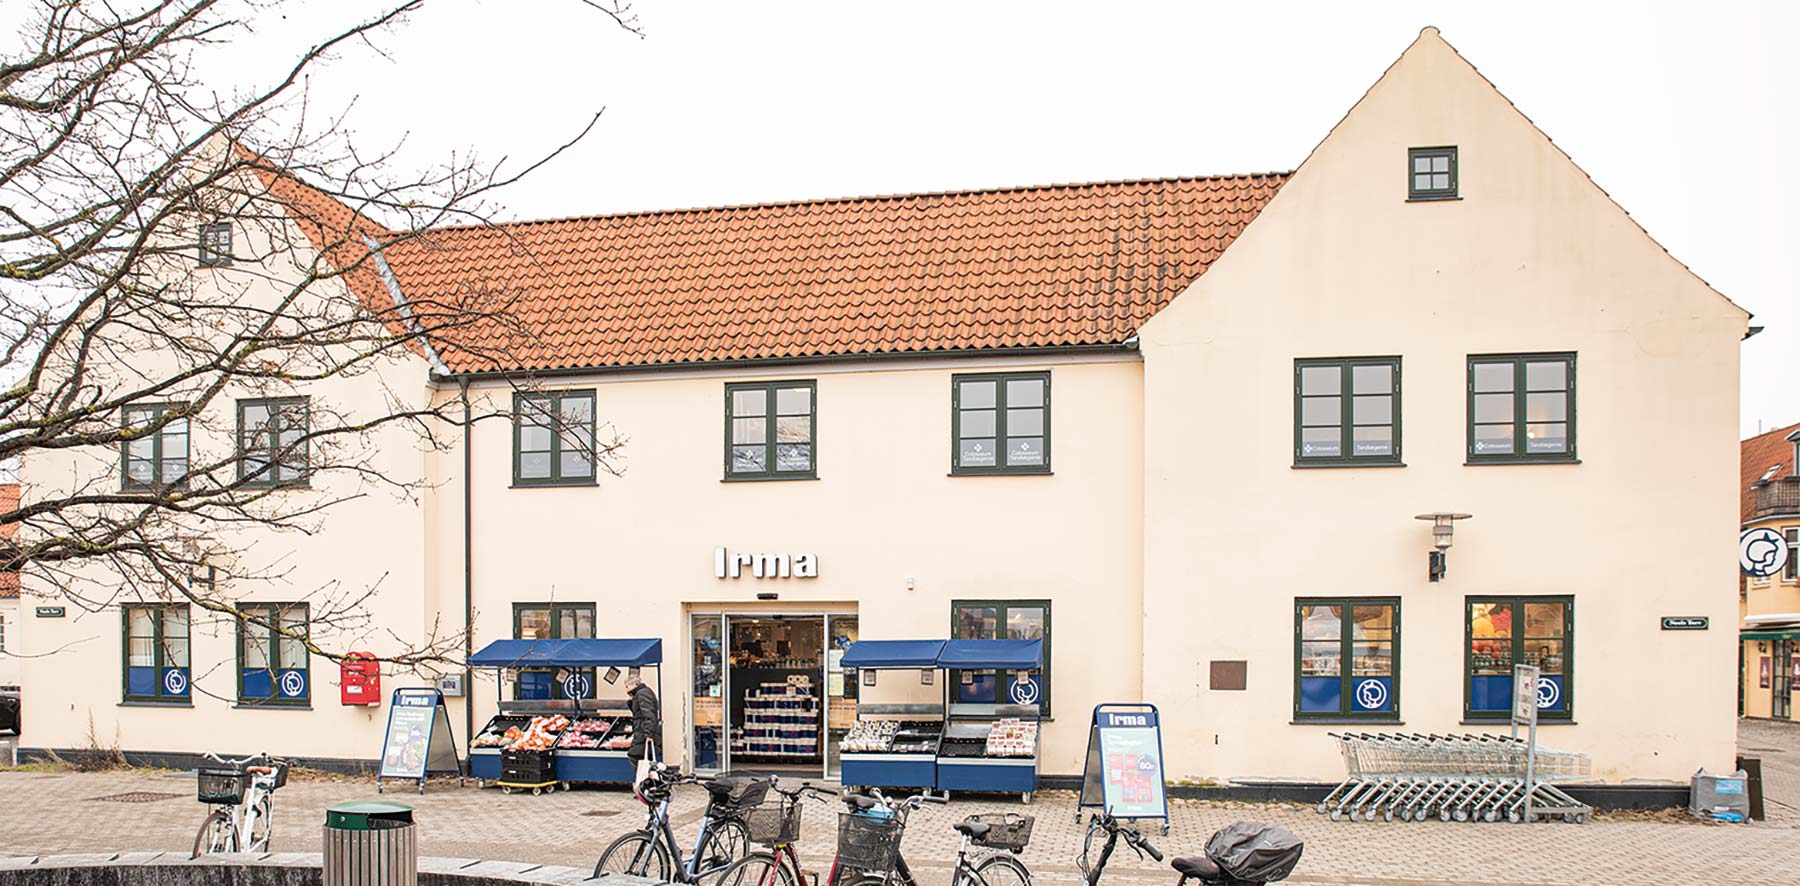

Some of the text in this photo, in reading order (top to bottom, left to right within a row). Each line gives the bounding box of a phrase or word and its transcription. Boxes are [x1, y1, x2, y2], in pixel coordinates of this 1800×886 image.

[714, 547, 818, 579] Irma
[401, 696, 429, 706] Irma
[1108, 713, 1147, 726] Irma
